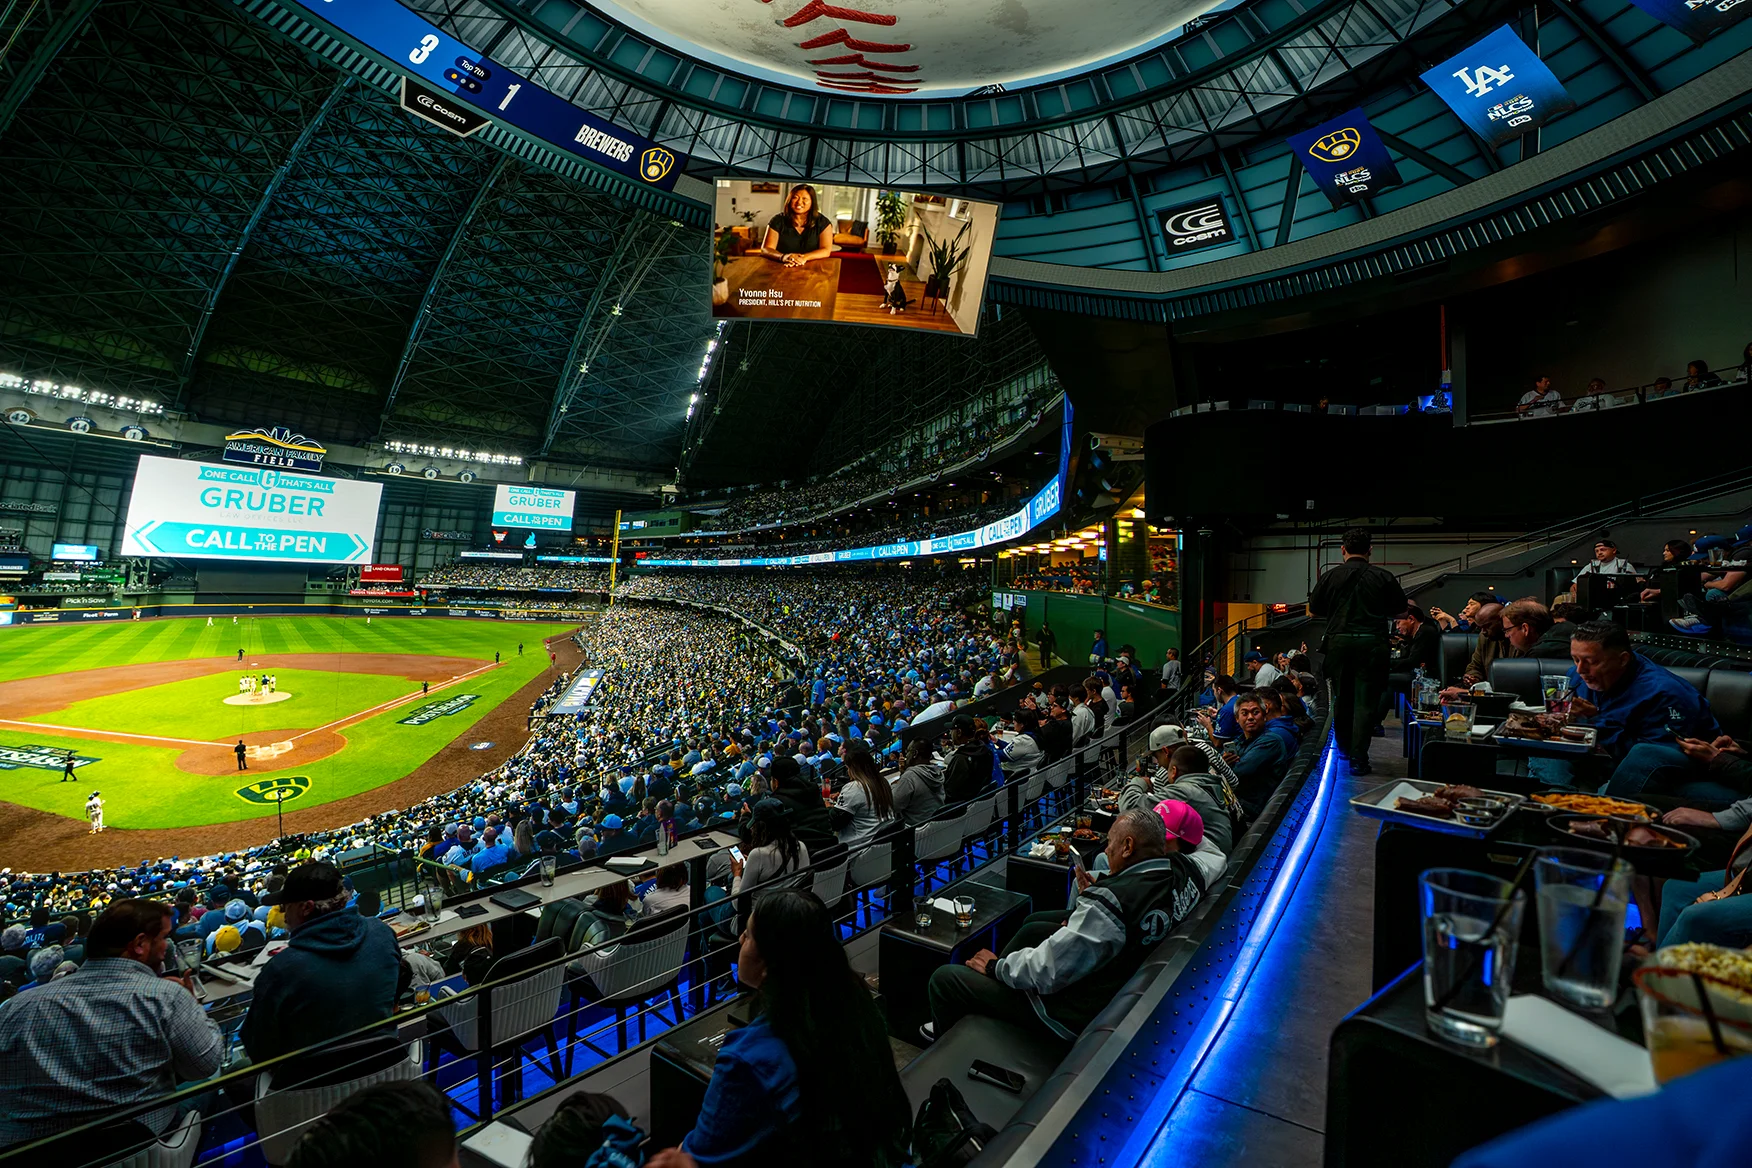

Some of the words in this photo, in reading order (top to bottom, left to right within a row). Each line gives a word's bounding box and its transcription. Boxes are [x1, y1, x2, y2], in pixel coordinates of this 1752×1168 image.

[409, 34, 439, 64] 3
[462, 60, 473, 71] Top
[474, 66, 485, 77] 7th
[1452, 64, 1515, 98] LA
[498, 83, 521, 111] 1
[433, 104, 466, 124] cosm
[1487, 96, 1533, 120] NLCS
[574, 124, 634, 163] BREWERS
[1335, 168, 1370, 185] NLCS
[1173, 228, 1226, 245] cosm
[739, 288, 767, 298] Yvonne
[768, 289, 783, 299] Hsu
[739, 299, 768, 307] PRESIDENT,
[768, 299, 784, 307] HILL'S
[795, 300, 821, 308] NUTRITION
[11, 413, 28, 423] 42
[73, 423, 87, 432] 44
[226, 441, 283, 456] AMERICAN
[286, 450, 324, 462] FAMILY
[254, 454, 294, 467] FIELD
[204, 469, 228, 479] ONE
[229, 473, 256, 482] CALL
[280, 478, 312, 488] THAT'S
[314, 482, 331, 490] ALL
[200, 487, 325, 517] GRUBER
[509, 496, 561, 508] GRUBER
[1034, 481, 1060, 520] GRUBER
[504, 514, 530, 524] CALL
[542, 516, 562, 526] PEN
[185, 529, 253, 550] CALL
[254, 542, 277, 551] THE
[258, 533, 275, 543] TO
[279, 534, 327, 553] PEN
[1668, 706, 1681, 719] LA
[1140, 877, 1200, 945] Ddgers
